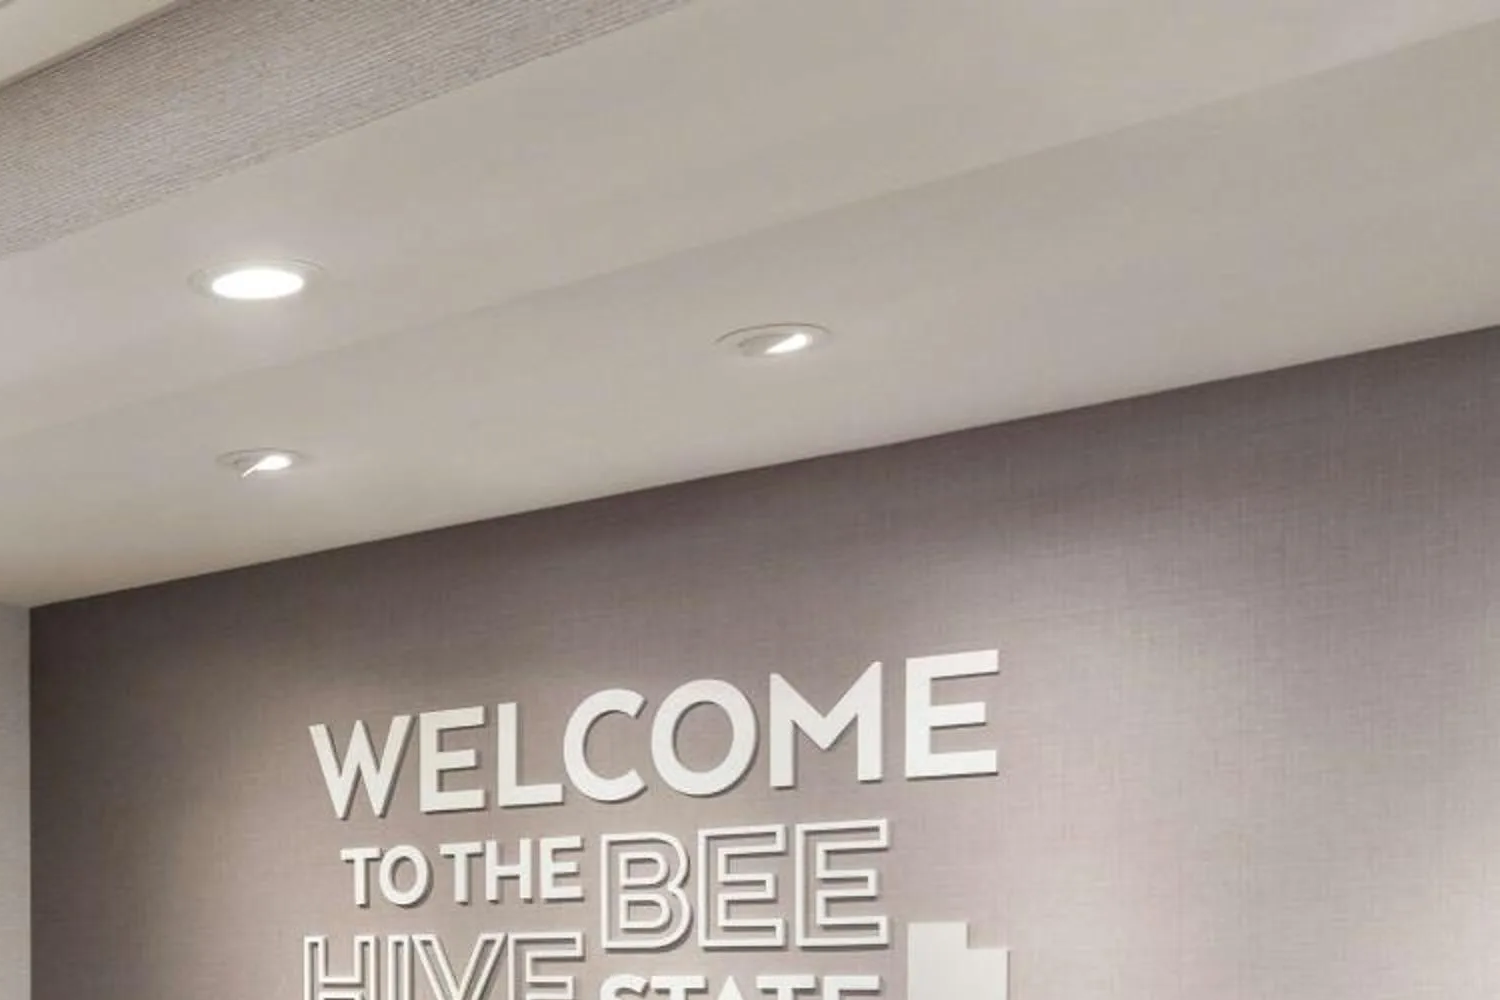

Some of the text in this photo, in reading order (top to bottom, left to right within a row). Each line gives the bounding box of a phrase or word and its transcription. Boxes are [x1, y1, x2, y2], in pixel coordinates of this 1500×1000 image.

[309, 650, 1001, 820] WELCOME
[340, 818, 890, 951] TO THE BEE
